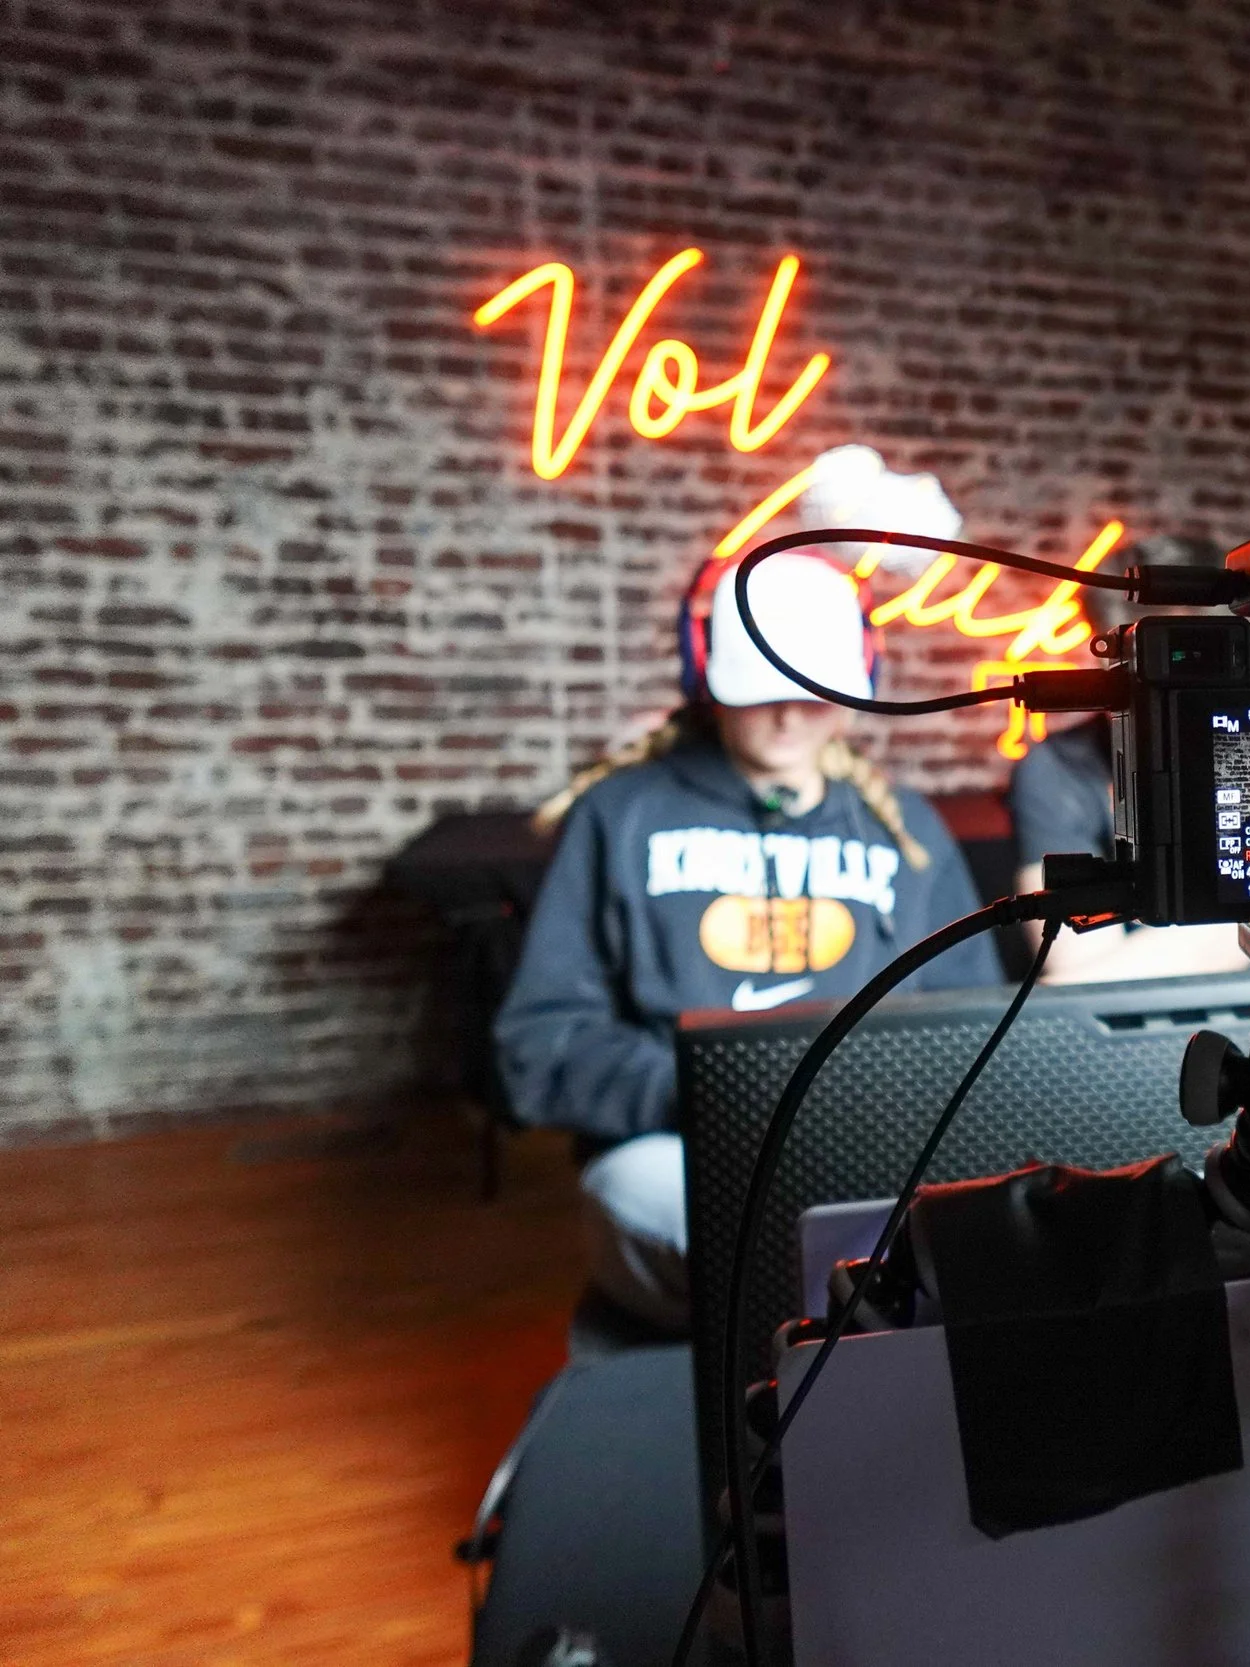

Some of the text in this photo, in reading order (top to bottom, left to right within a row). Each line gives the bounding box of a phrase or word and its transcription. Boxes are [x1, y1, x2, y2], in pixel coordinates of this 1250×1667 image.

[473, 246, 831, 481] Vol
[1227, 720, 1240, 732] M
[1232, 860, 1244, 869] AF
